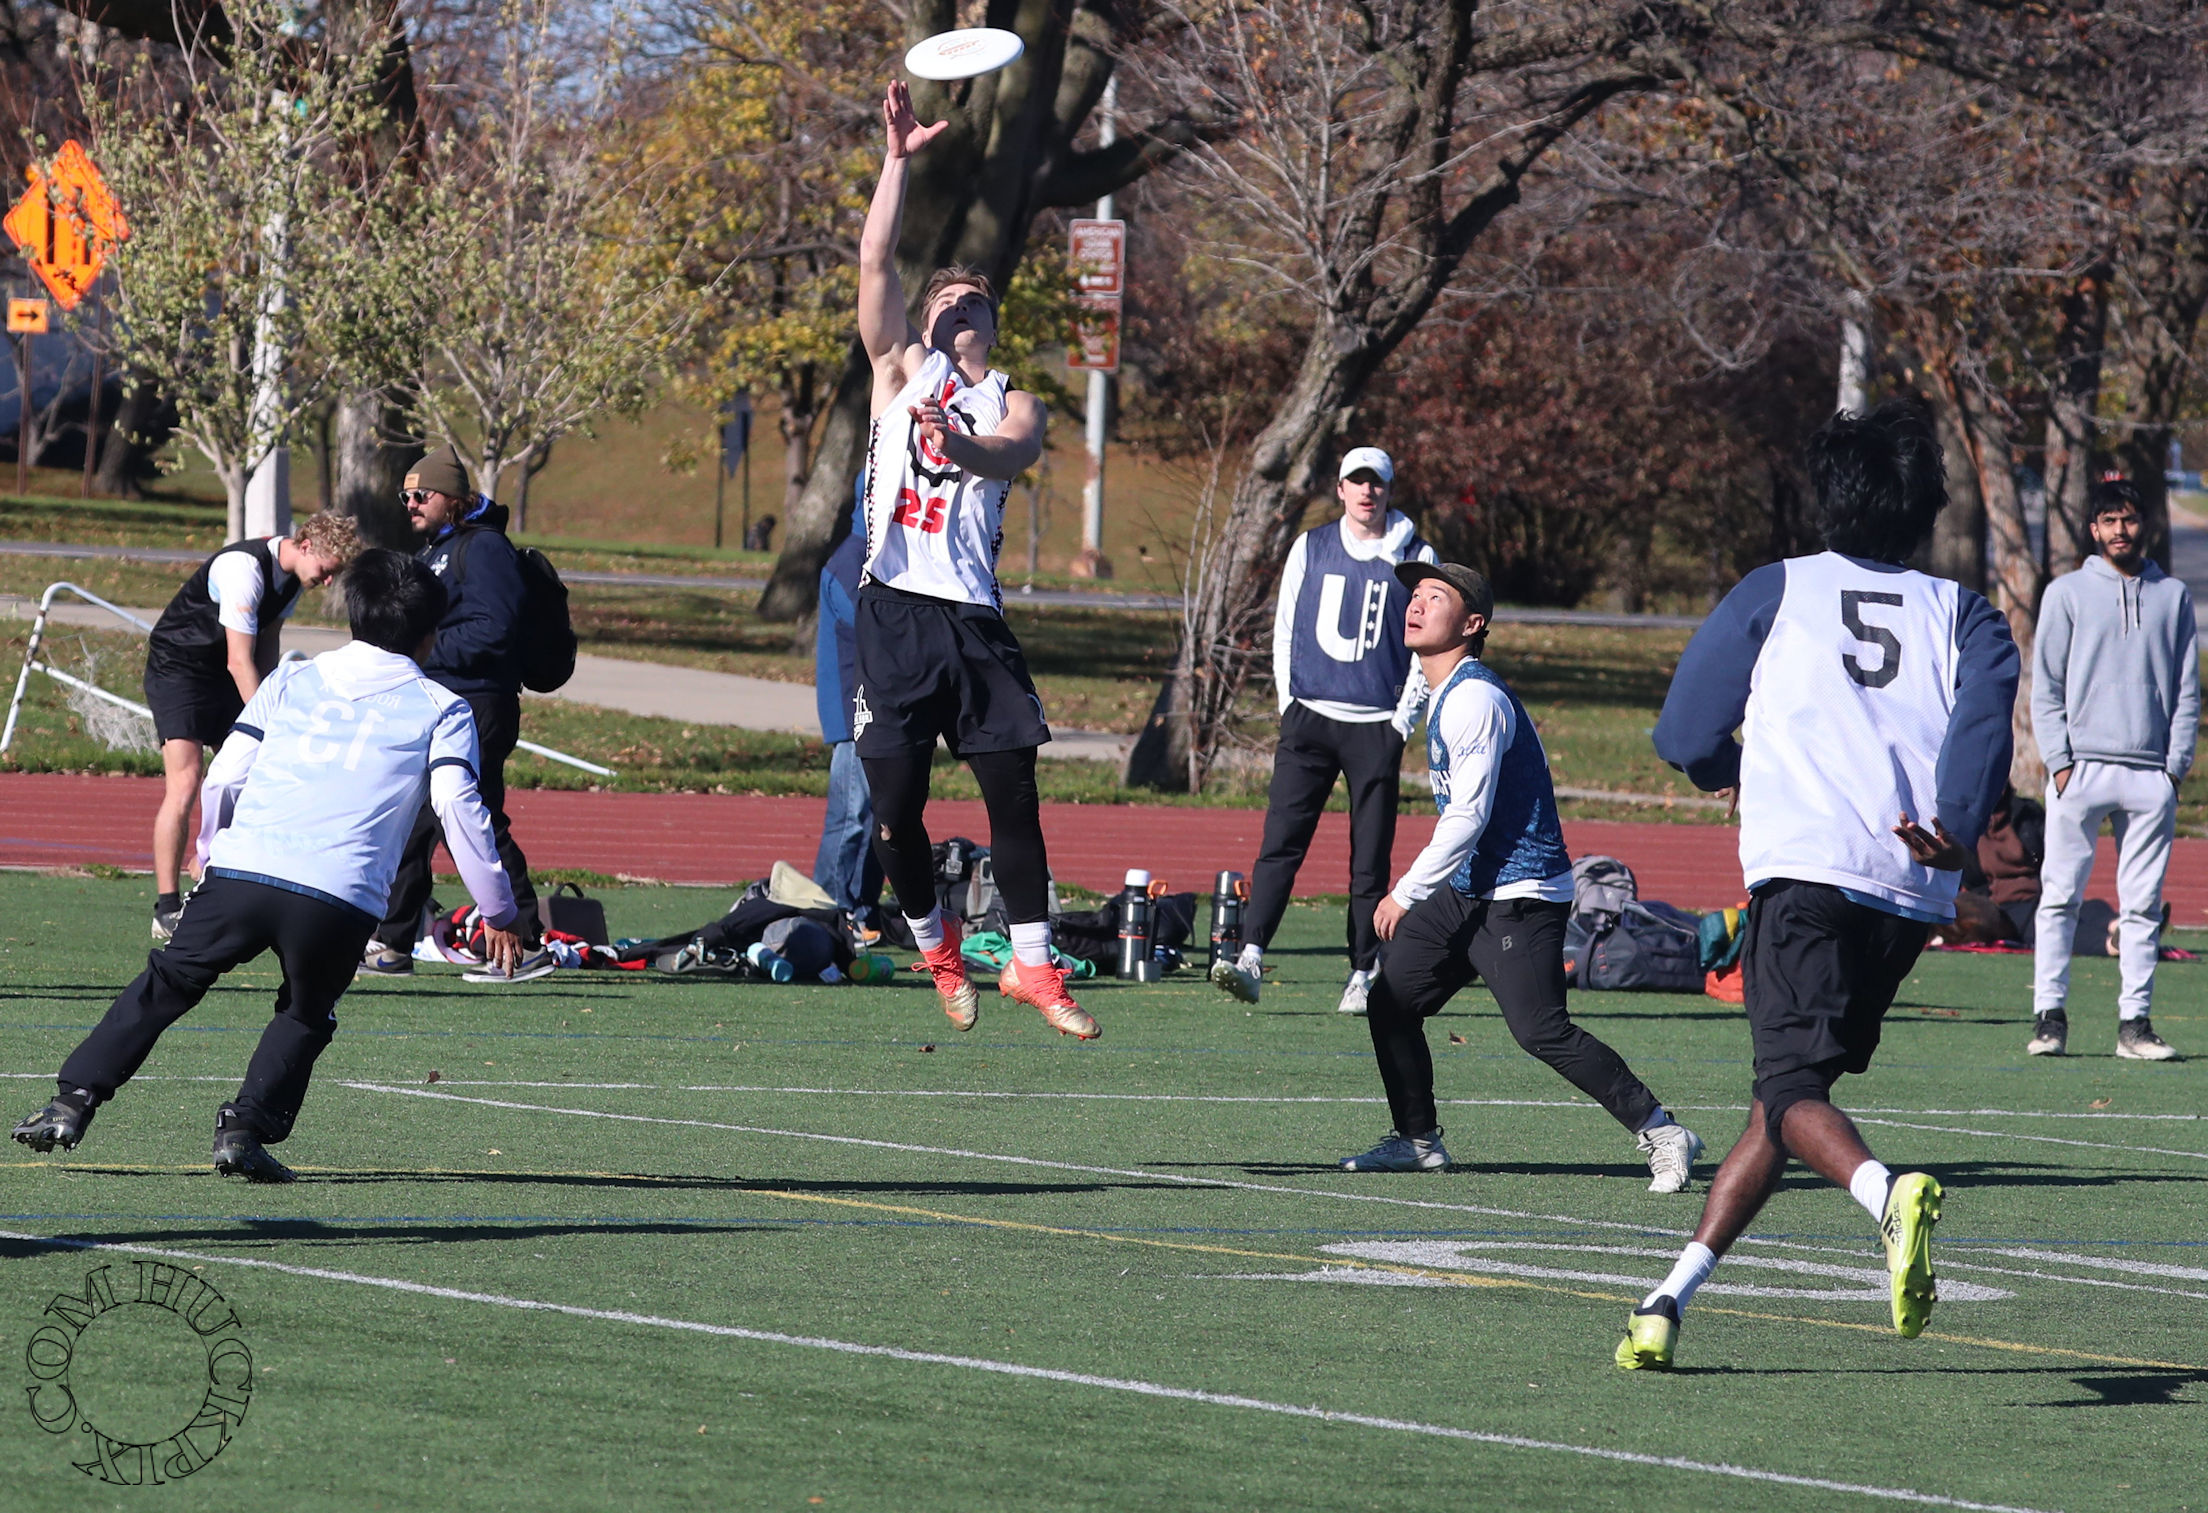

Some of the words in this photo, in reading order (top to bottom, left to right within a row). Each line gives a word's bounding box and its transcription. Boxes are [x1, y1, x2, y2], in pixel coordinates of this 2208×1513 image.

[892, 488, 947, 534] 25
[1841, 590, 1903, 689] 5
[1893, 1201, 1905, 1249] adidas
